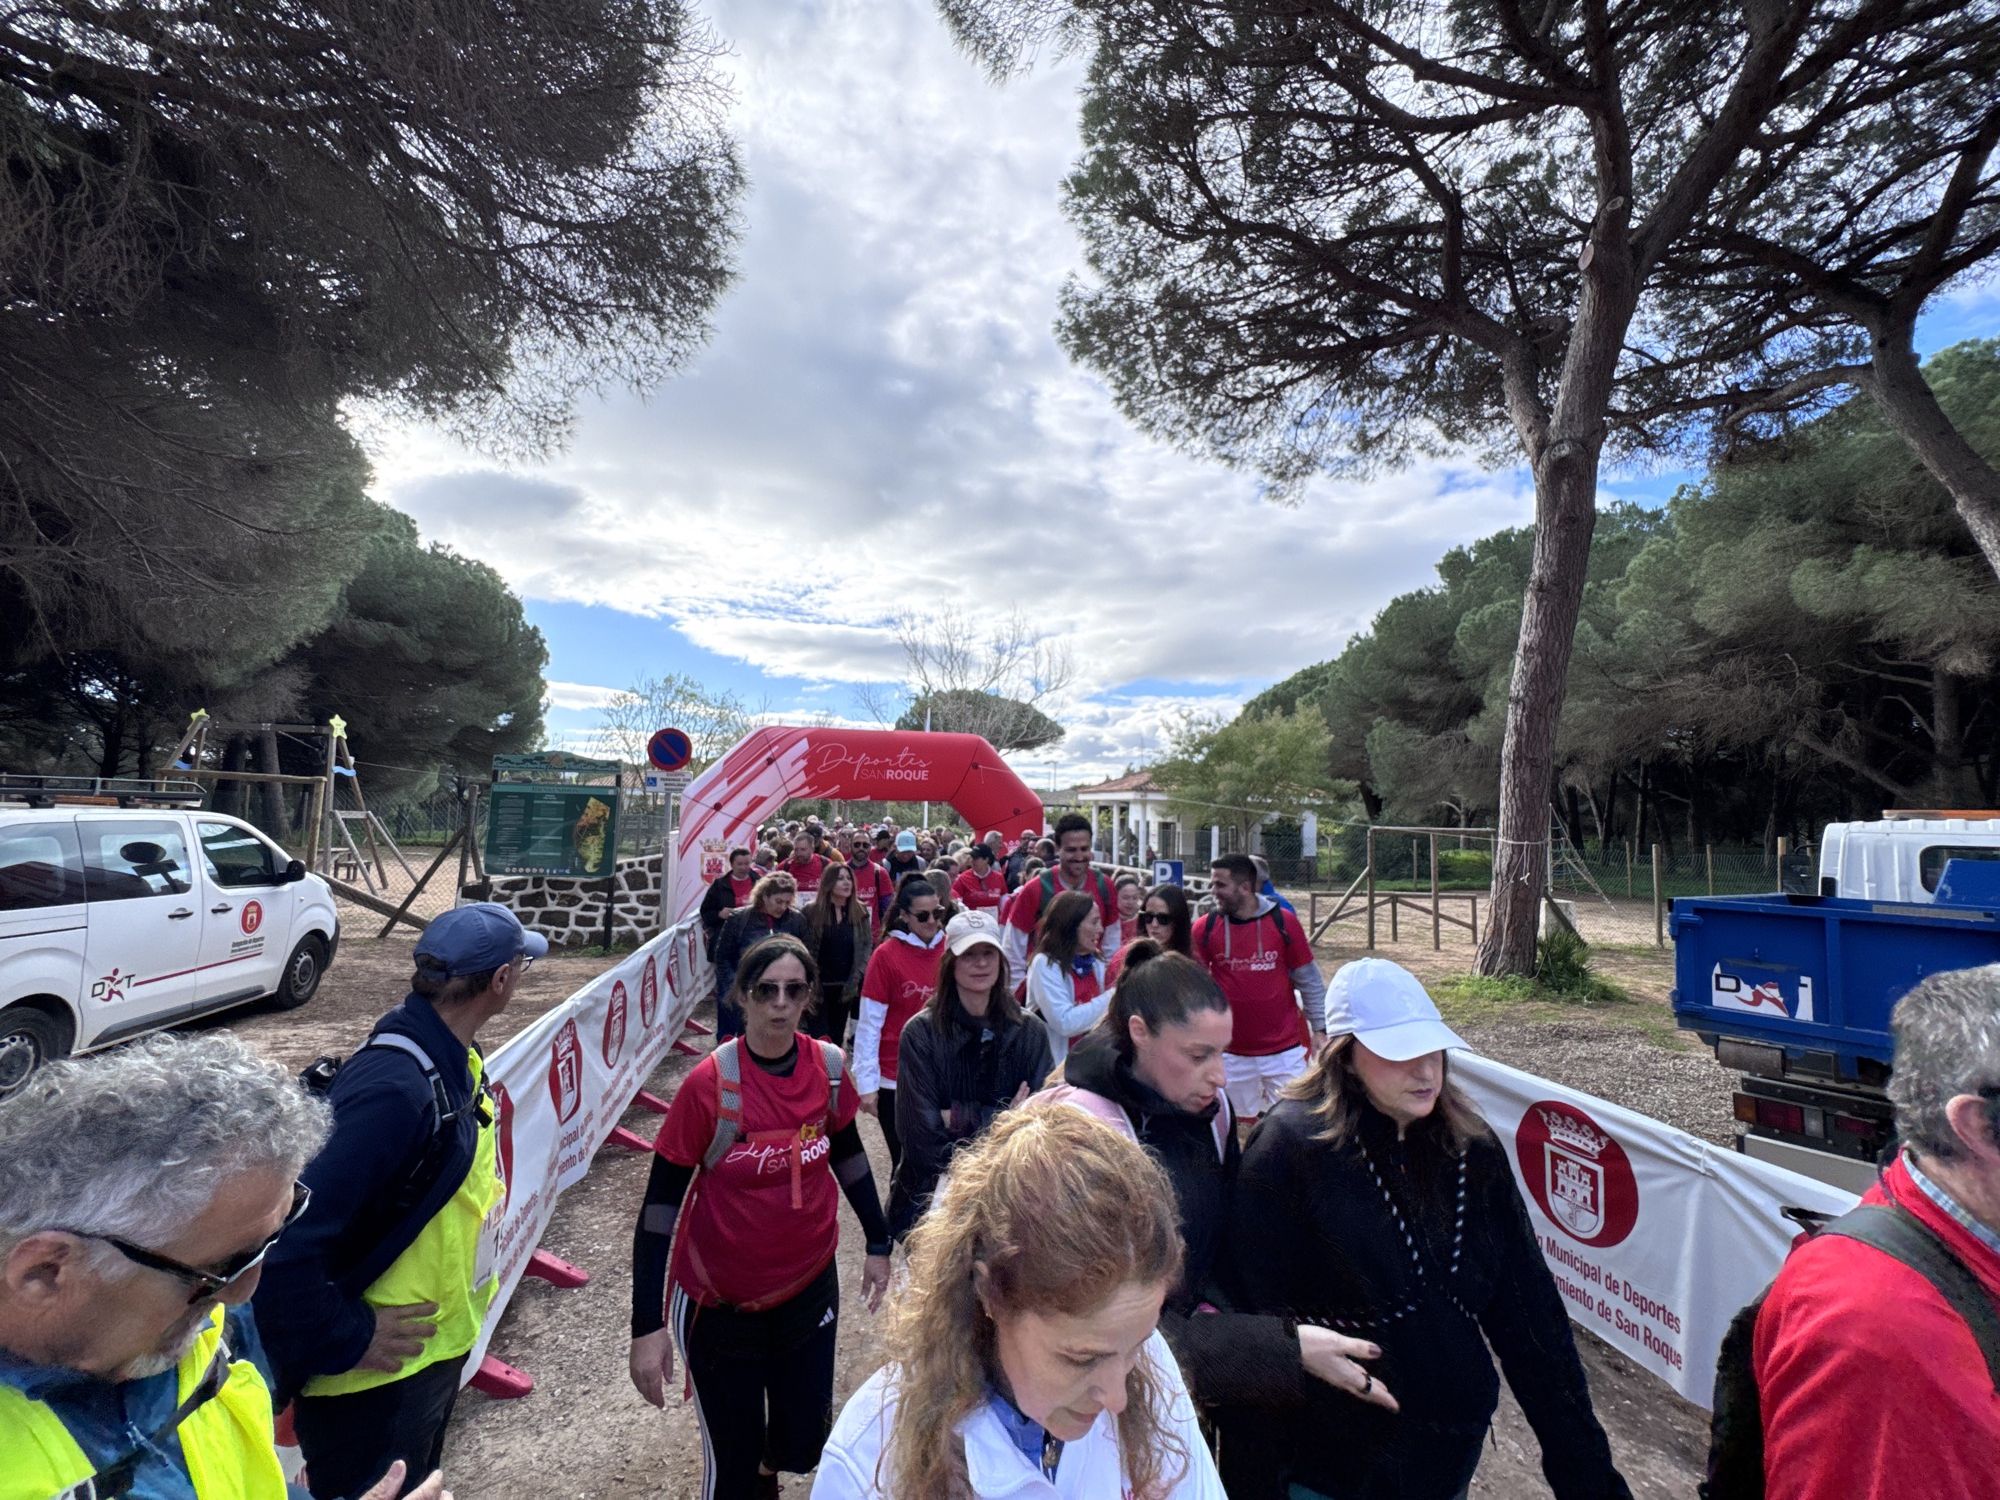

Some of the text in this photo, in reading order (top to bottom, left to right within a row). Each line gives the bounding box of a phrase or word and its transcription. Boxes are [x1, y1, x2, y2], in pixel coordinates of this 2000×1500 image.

[816, 742, 933, 781] Deportes
[1155, 862, 1173, 886] P
[1546, 1236, 1681, 1335] Municipal de Deportes
[1597, 1299, 1612, 1323] de
[1615, 1309, 1640, 1342] San
[1643, 1325, 1682, 1371] Roque
